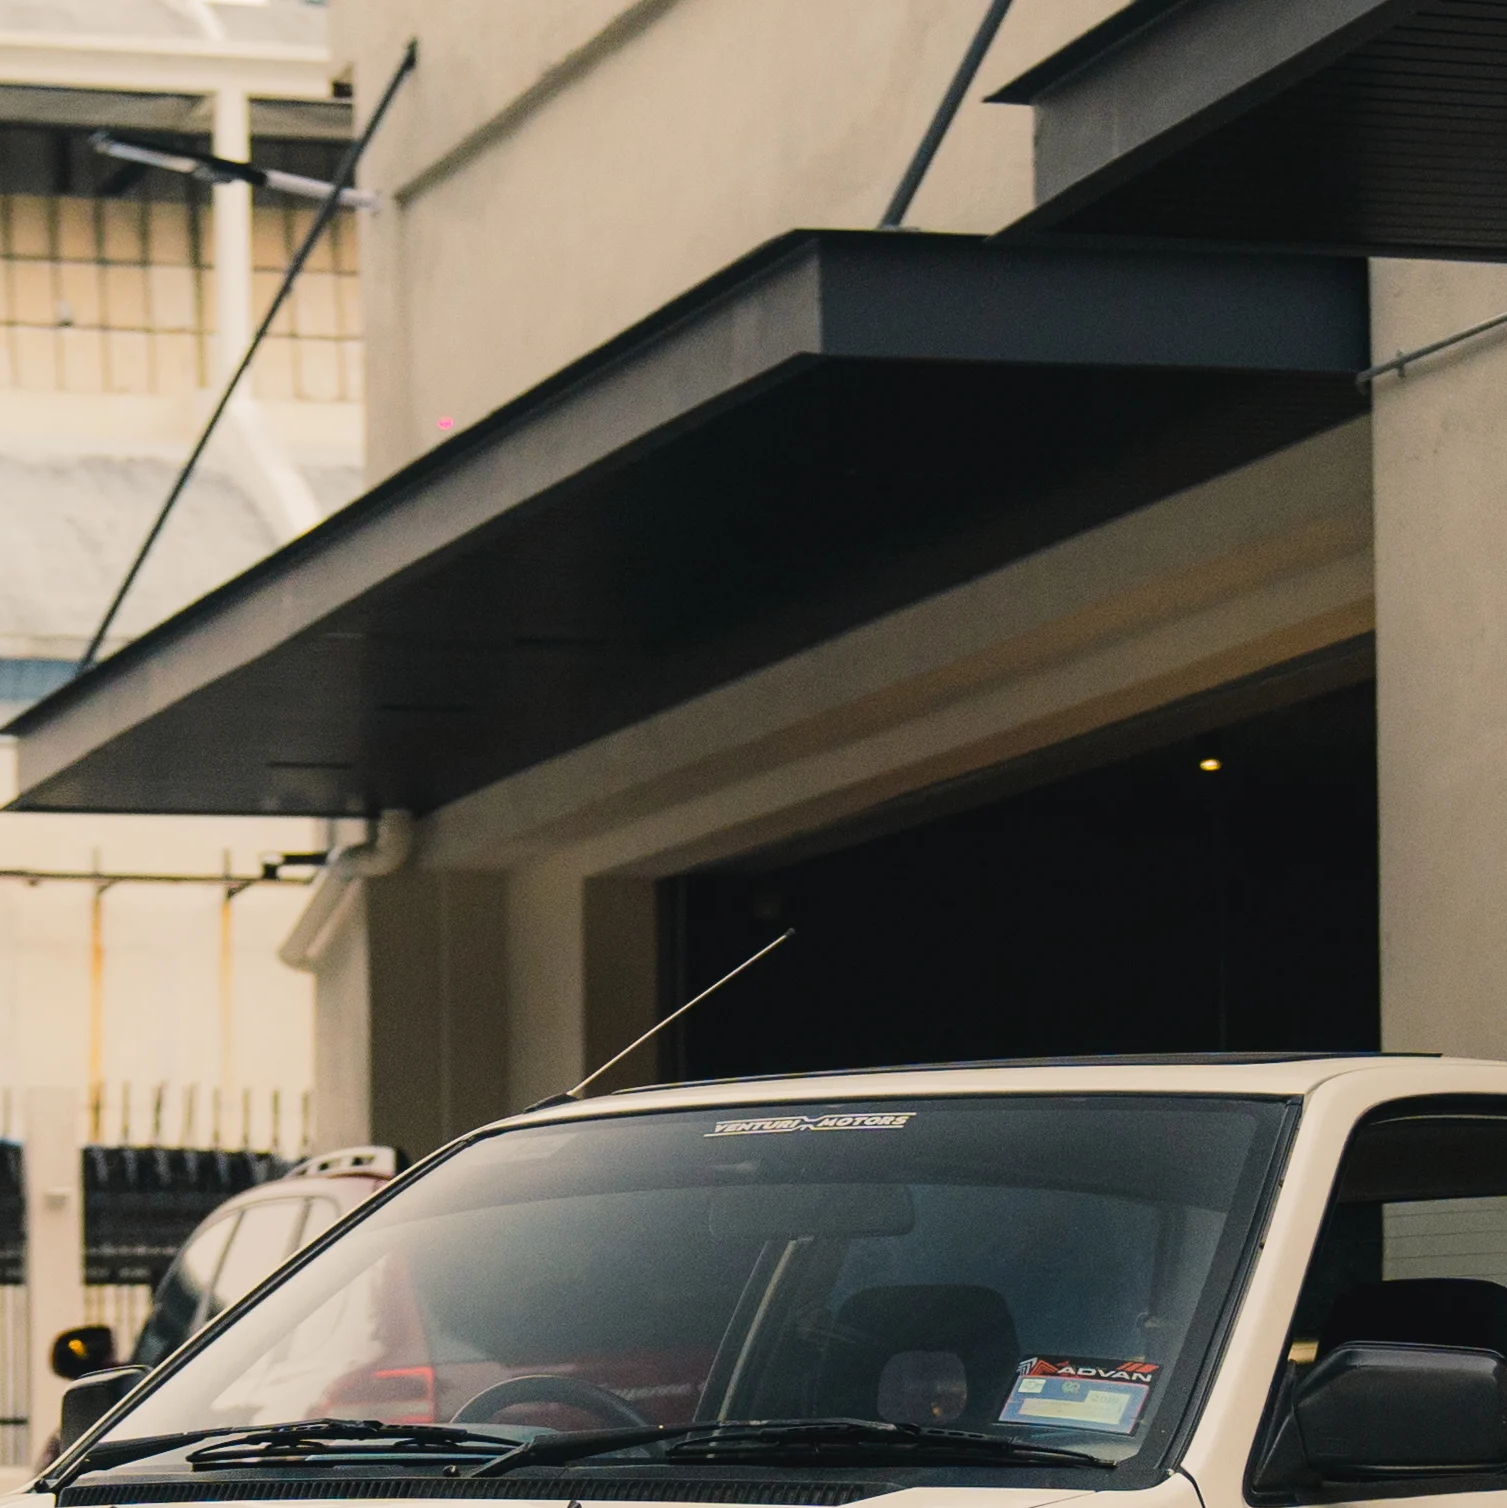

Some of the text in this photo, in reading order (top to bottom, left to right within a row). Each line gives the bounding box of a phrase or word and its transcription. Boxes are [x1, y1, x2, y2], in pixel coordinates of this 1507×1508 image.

[714, 1116, 910, 1133] VENTURI MOTORS
[1058, 1367, 1153, 1382] ADVAN
